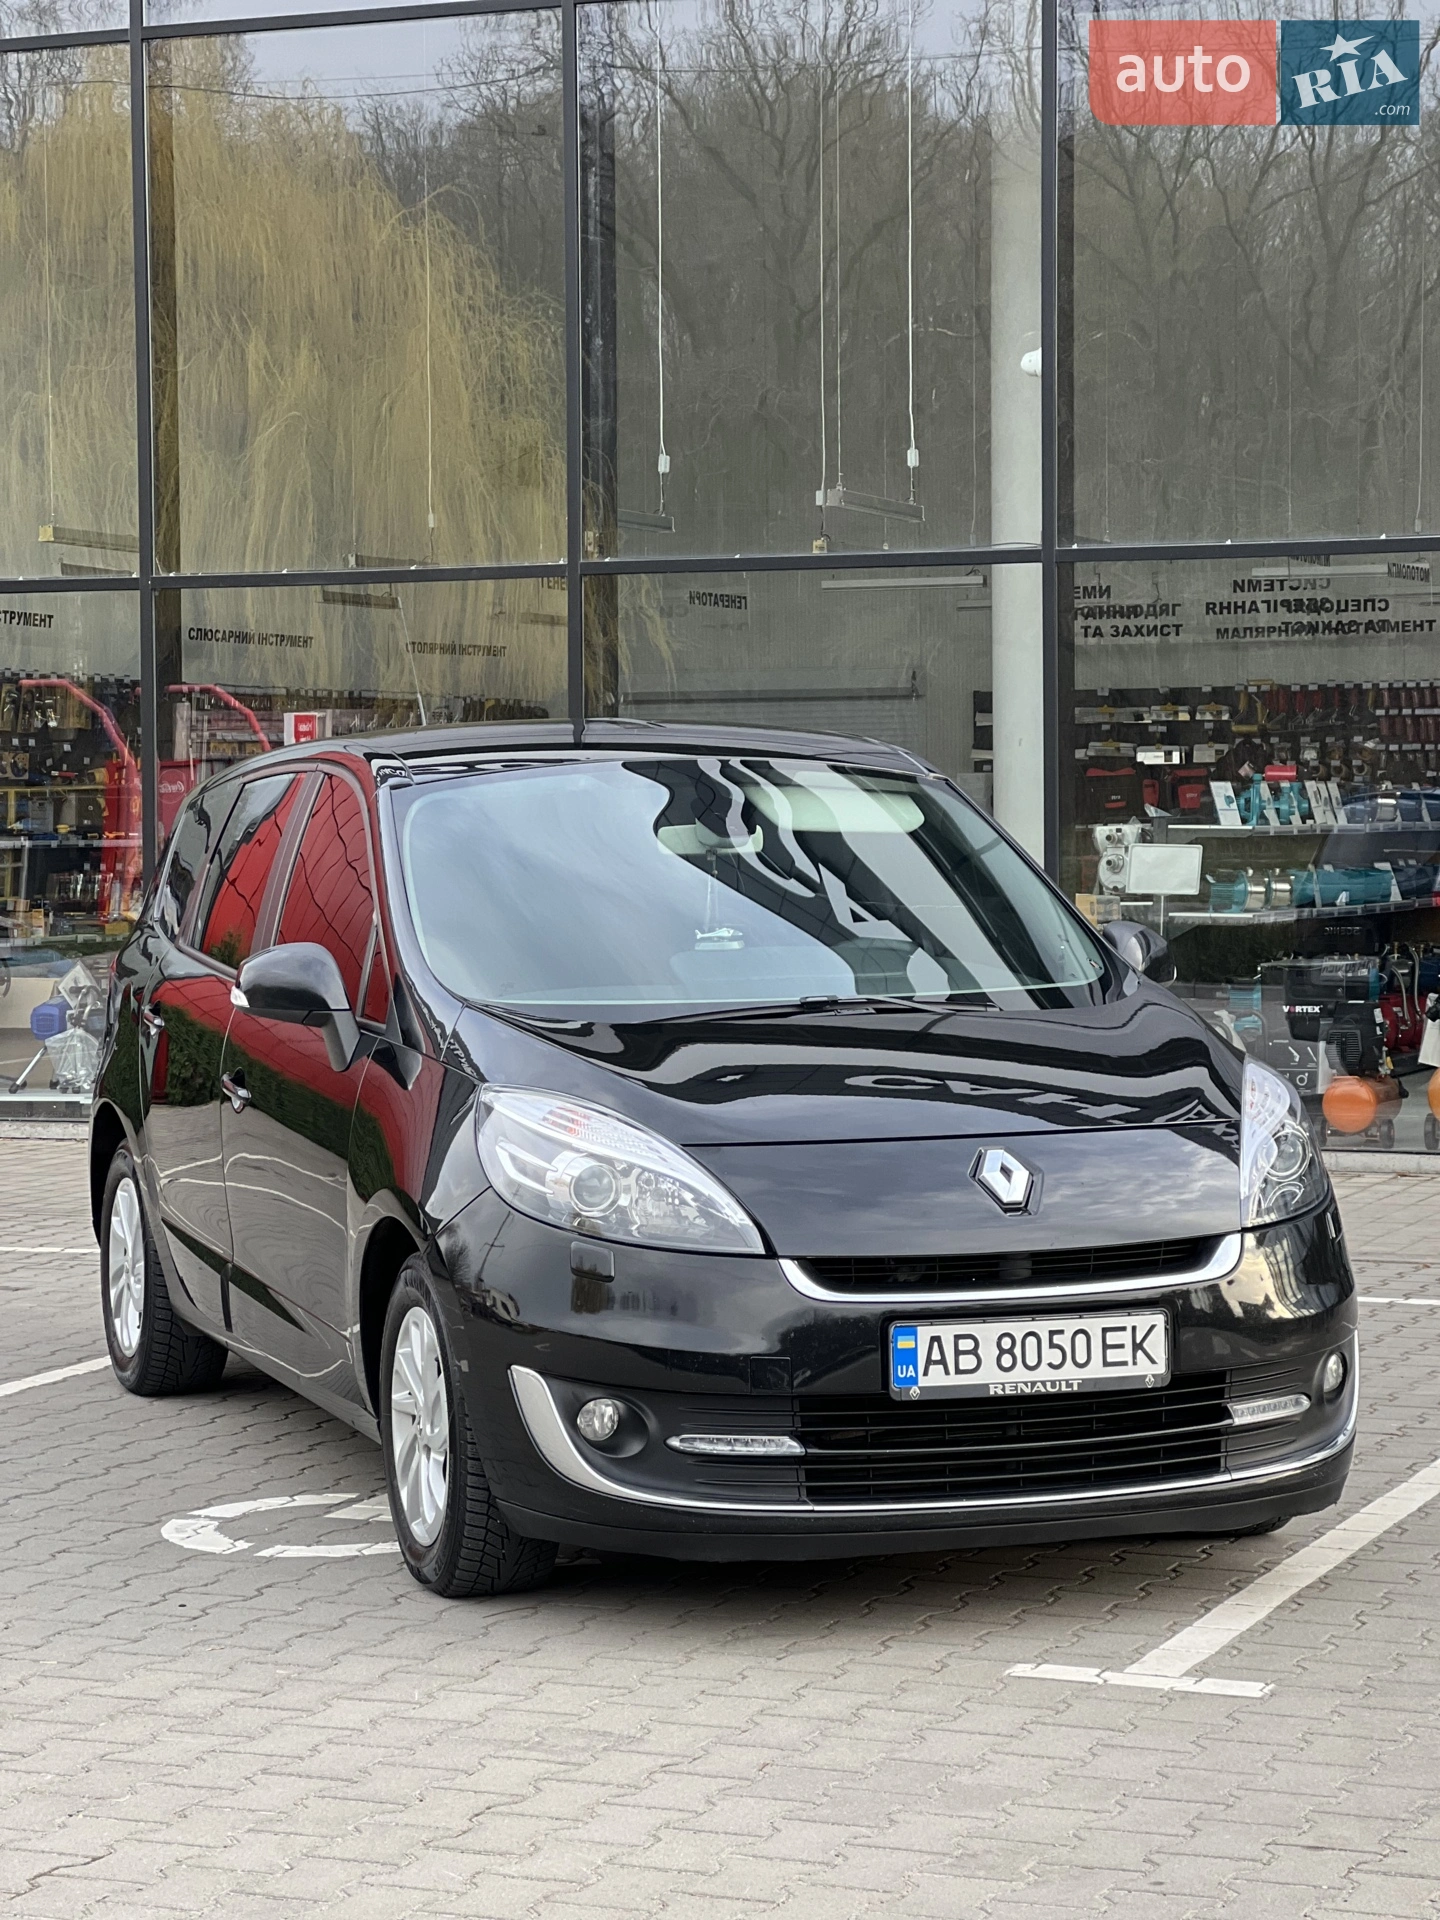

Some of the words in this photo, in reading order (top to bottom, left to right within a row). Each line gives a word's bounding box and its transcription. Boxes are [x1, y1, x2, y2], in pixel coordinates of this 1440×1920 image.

[0, 609, 54, 628] ТРУМЕНТ
[188, 627, 256, 645] СЛЮСАРНИЙ
[257, 632, 314, 648] ІНСТРУМЕНТ
[1080, 624, 1104, 638] ТА
[1110, 623, 1183, 638] ЗАХИСТ
[1282, 1004, 1321, 1013] VORTEX
[922, 1333, 983, 1377] AB
[995, 1328, 1092, 1374] 8050
[1101, 1323, 1159, 1367] EK
[897, 1364, 916, 1378] UA
[988, 1380, 1083, 1396] RENAULT
